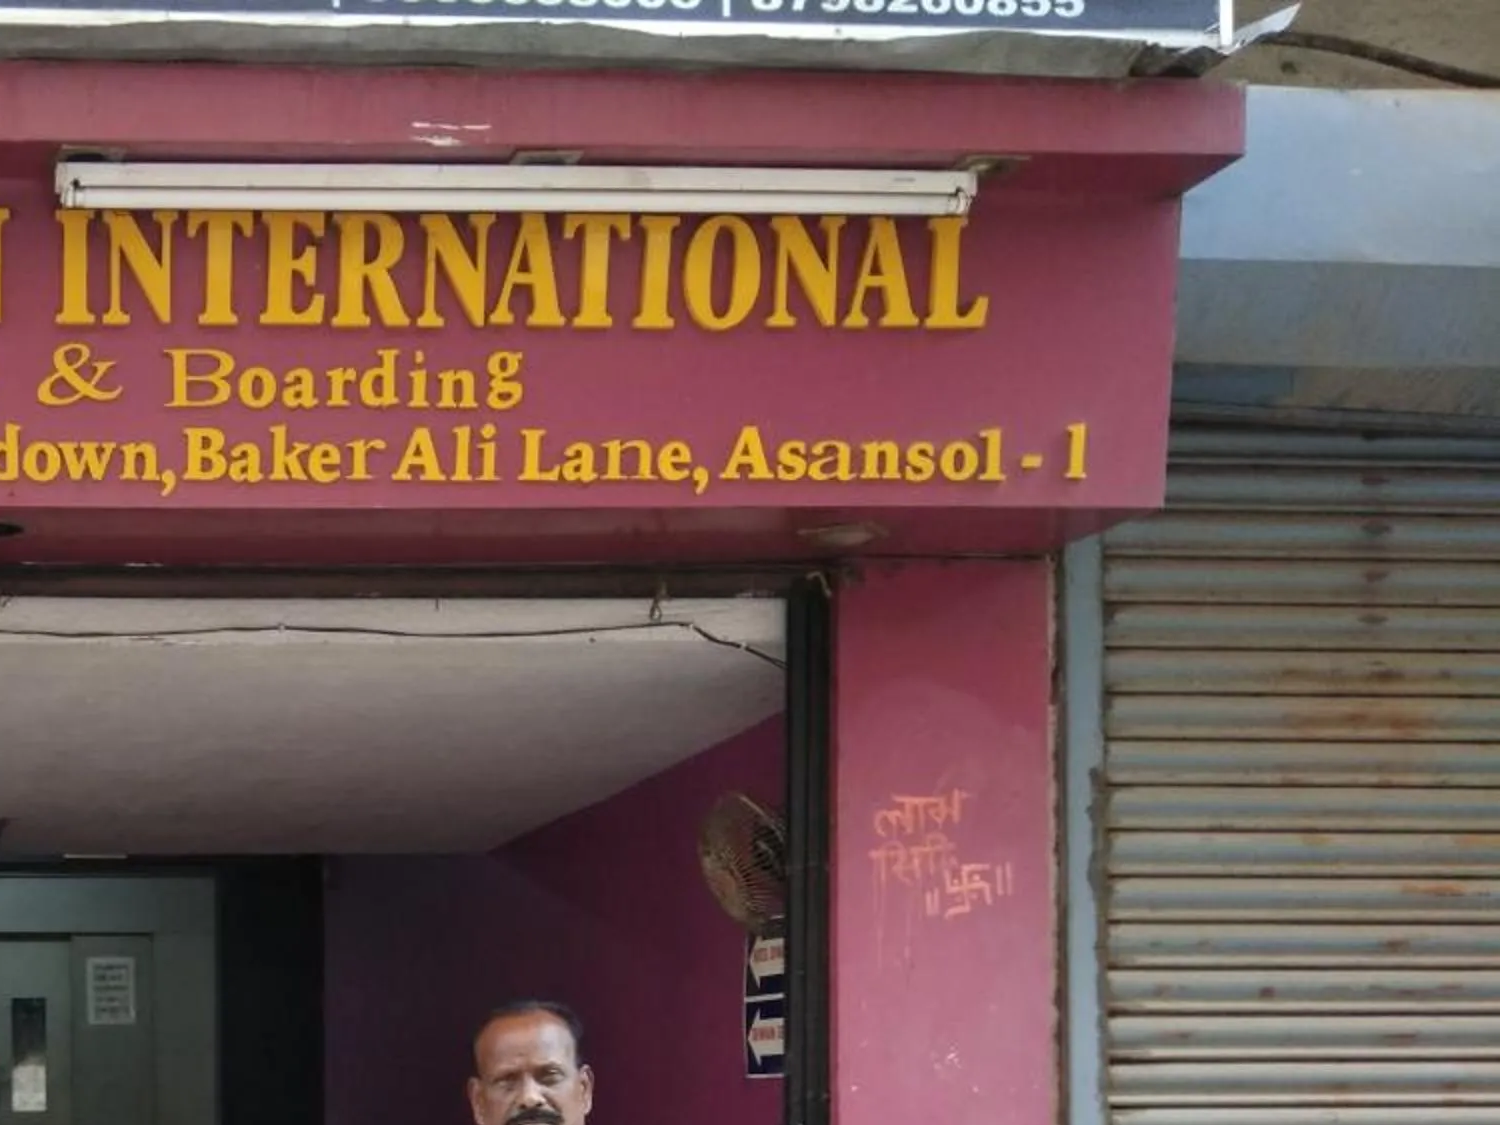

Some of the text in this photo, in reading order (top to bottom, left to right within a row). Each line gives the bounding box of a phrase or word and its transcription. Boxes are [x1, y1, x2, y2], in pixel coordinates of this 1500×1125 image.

[55, 207, 990, 332] INTERNATIONAL
[36, 342, 124, 406] &
[164, 346, 525, 411] Boarding
[183, 423, 388, 484] Baker
[391, 424, 501, 483] Ali
[517, 427, 711, 493] Lane,
[719, 425, 1006, 484] Asansol
